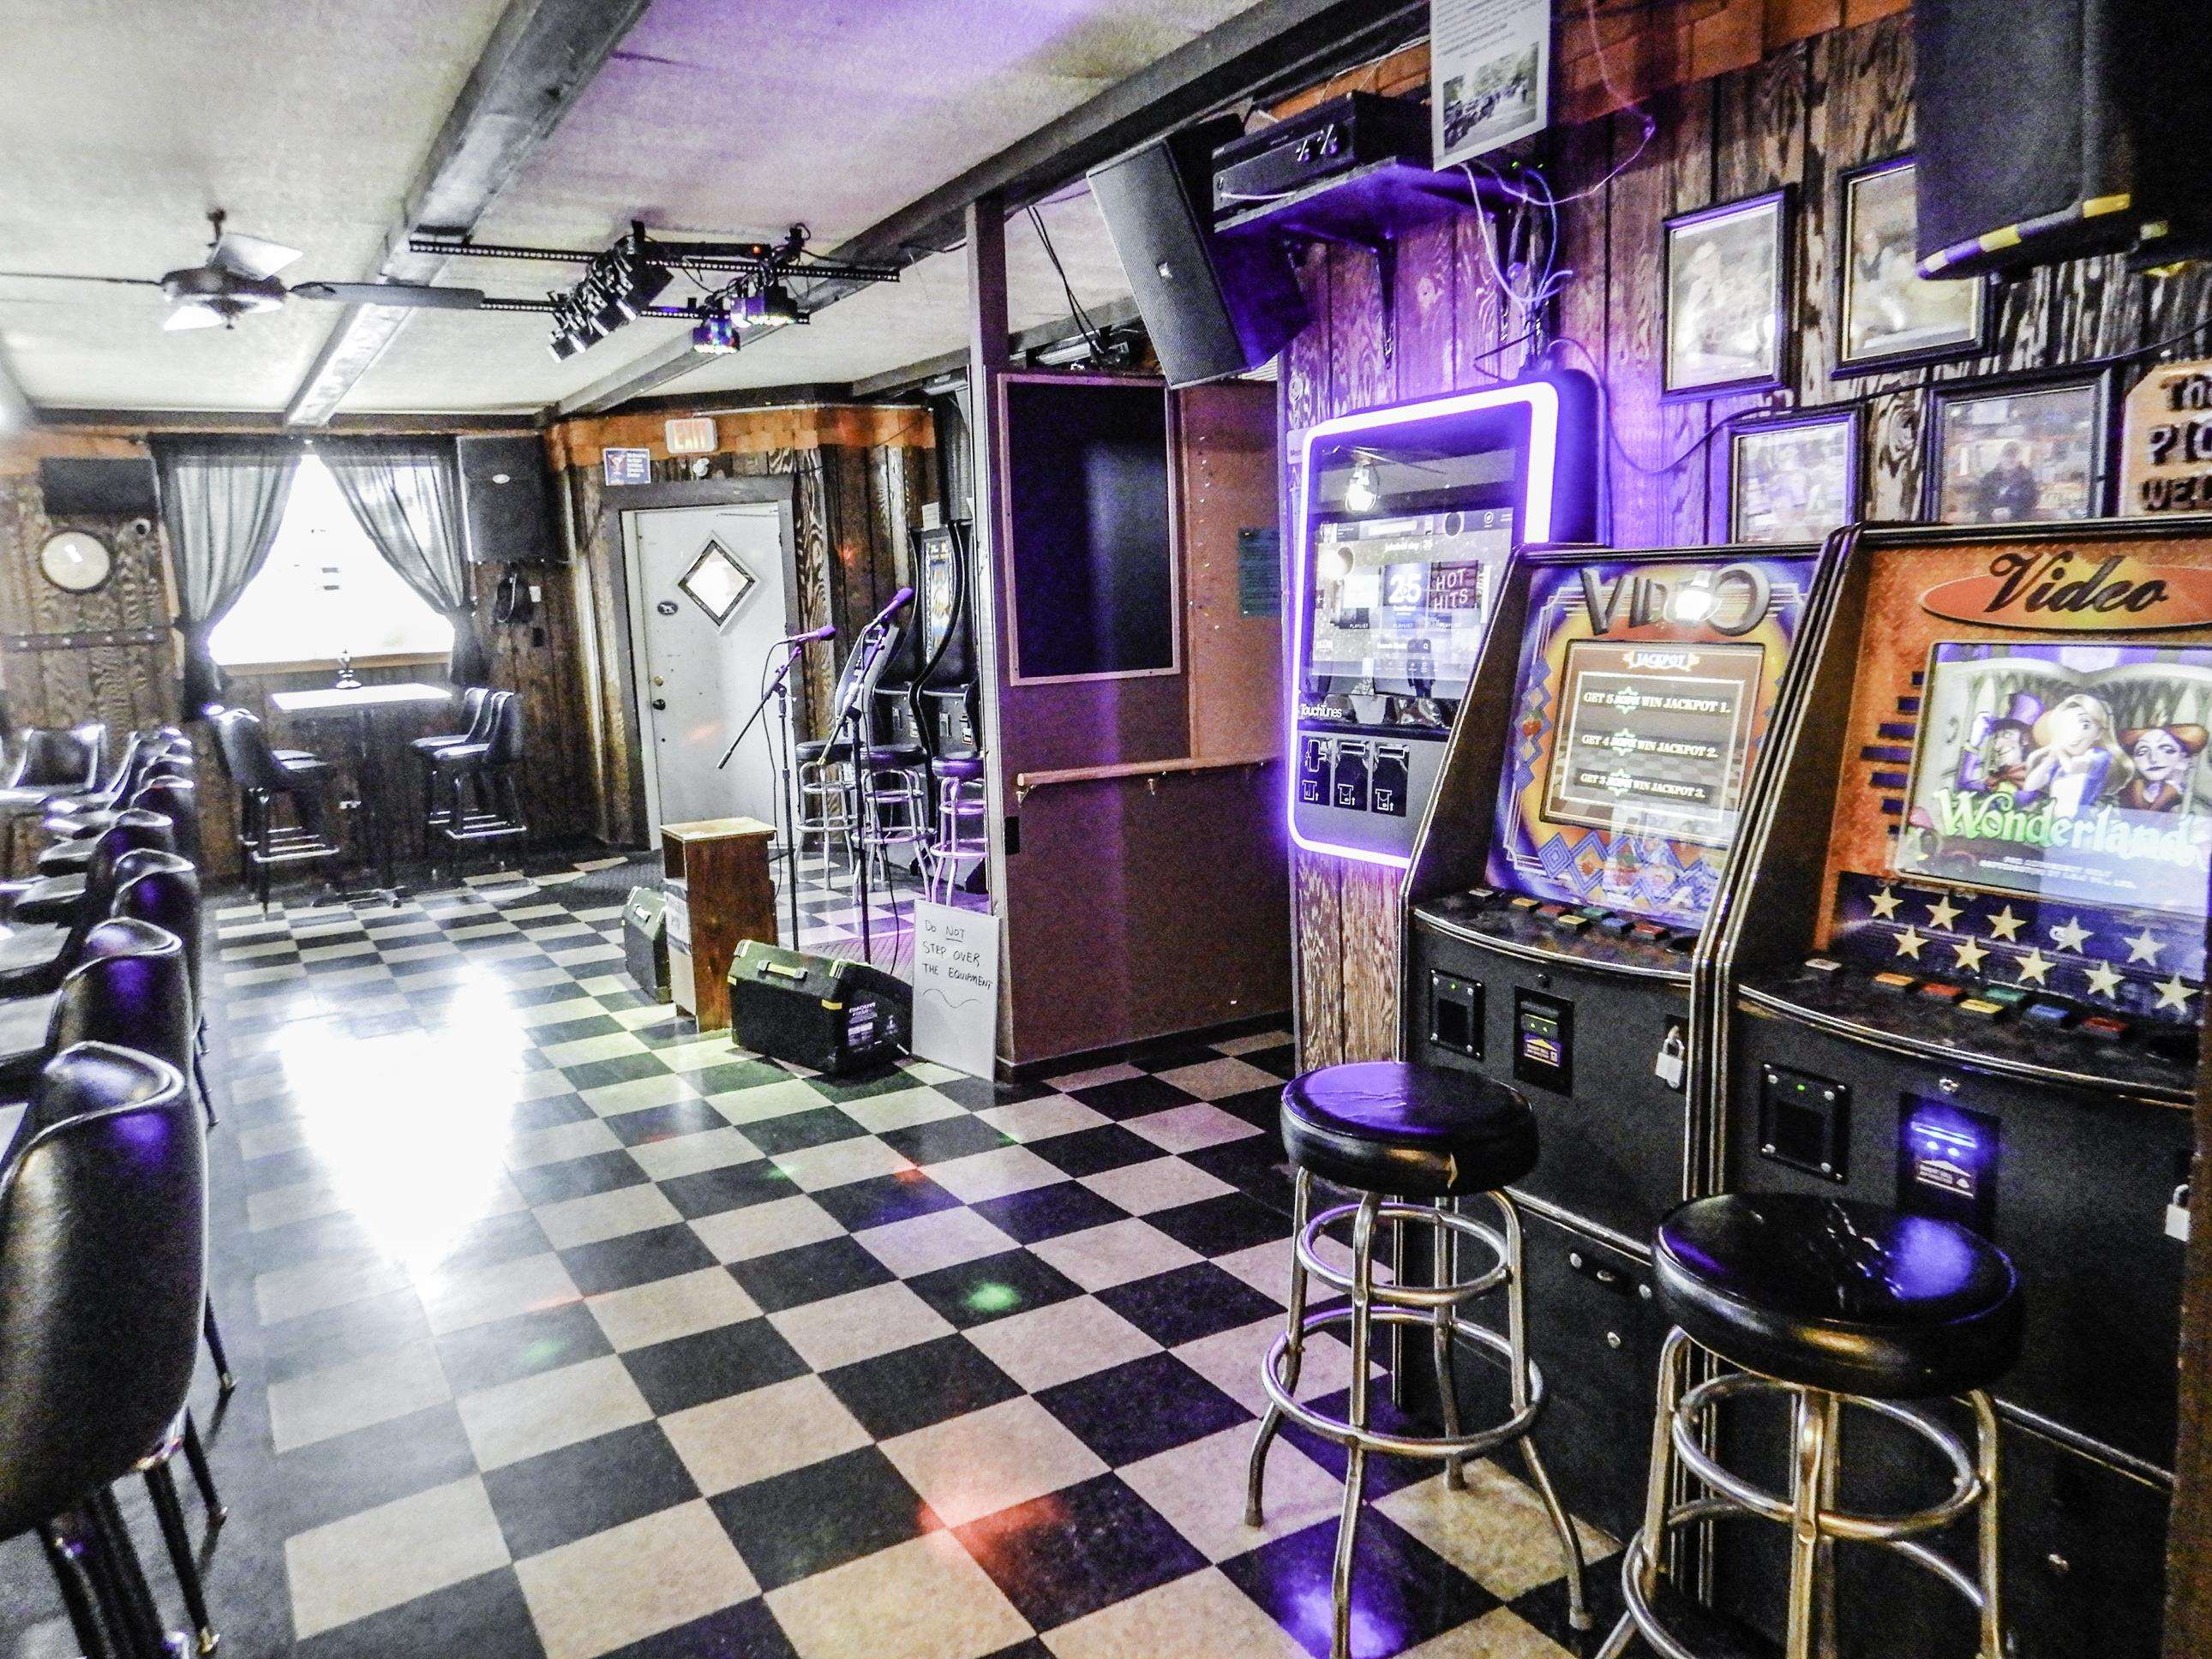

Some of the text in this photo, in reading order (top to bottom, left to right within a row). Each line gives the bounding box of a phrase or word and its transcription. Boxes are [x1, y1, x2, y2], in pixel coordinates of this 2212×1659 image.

[671, 421, 709, 449] EXIT
[1388, 572, 1422, 604] 25
[1436, 568, 1466, 592] HOT
[1984, 550, 2169, 613] Video
[1434, 588, 1468, 613] HITS
[1580, 562, 1771, 637] VIDO
[1636, 652, 1687, 666] JACKPOT
[1299, 703, 1342, 718] TouchTunes
[1584, 692, 1605, 704] GET
[1642, 696, 1663, 708] WIN
[1663, 698, 1718, 713] JACKPOT
[1581, 734, 1600, 746] GET
[1638, 740, 1657, 752] WIN
[1657, 741, 1706, 757] JACKPOT
[1580, 773, 1598, 784] GET
[1634, 778, 1652, 790] WIN
[1652, 781, 1694, 797] JACKPOT
[946, 925, 966, 939] NOT
[922, 941, 980, 967] STEP OVER
[922, 963, 993, 991] THE EQUIPMENT
